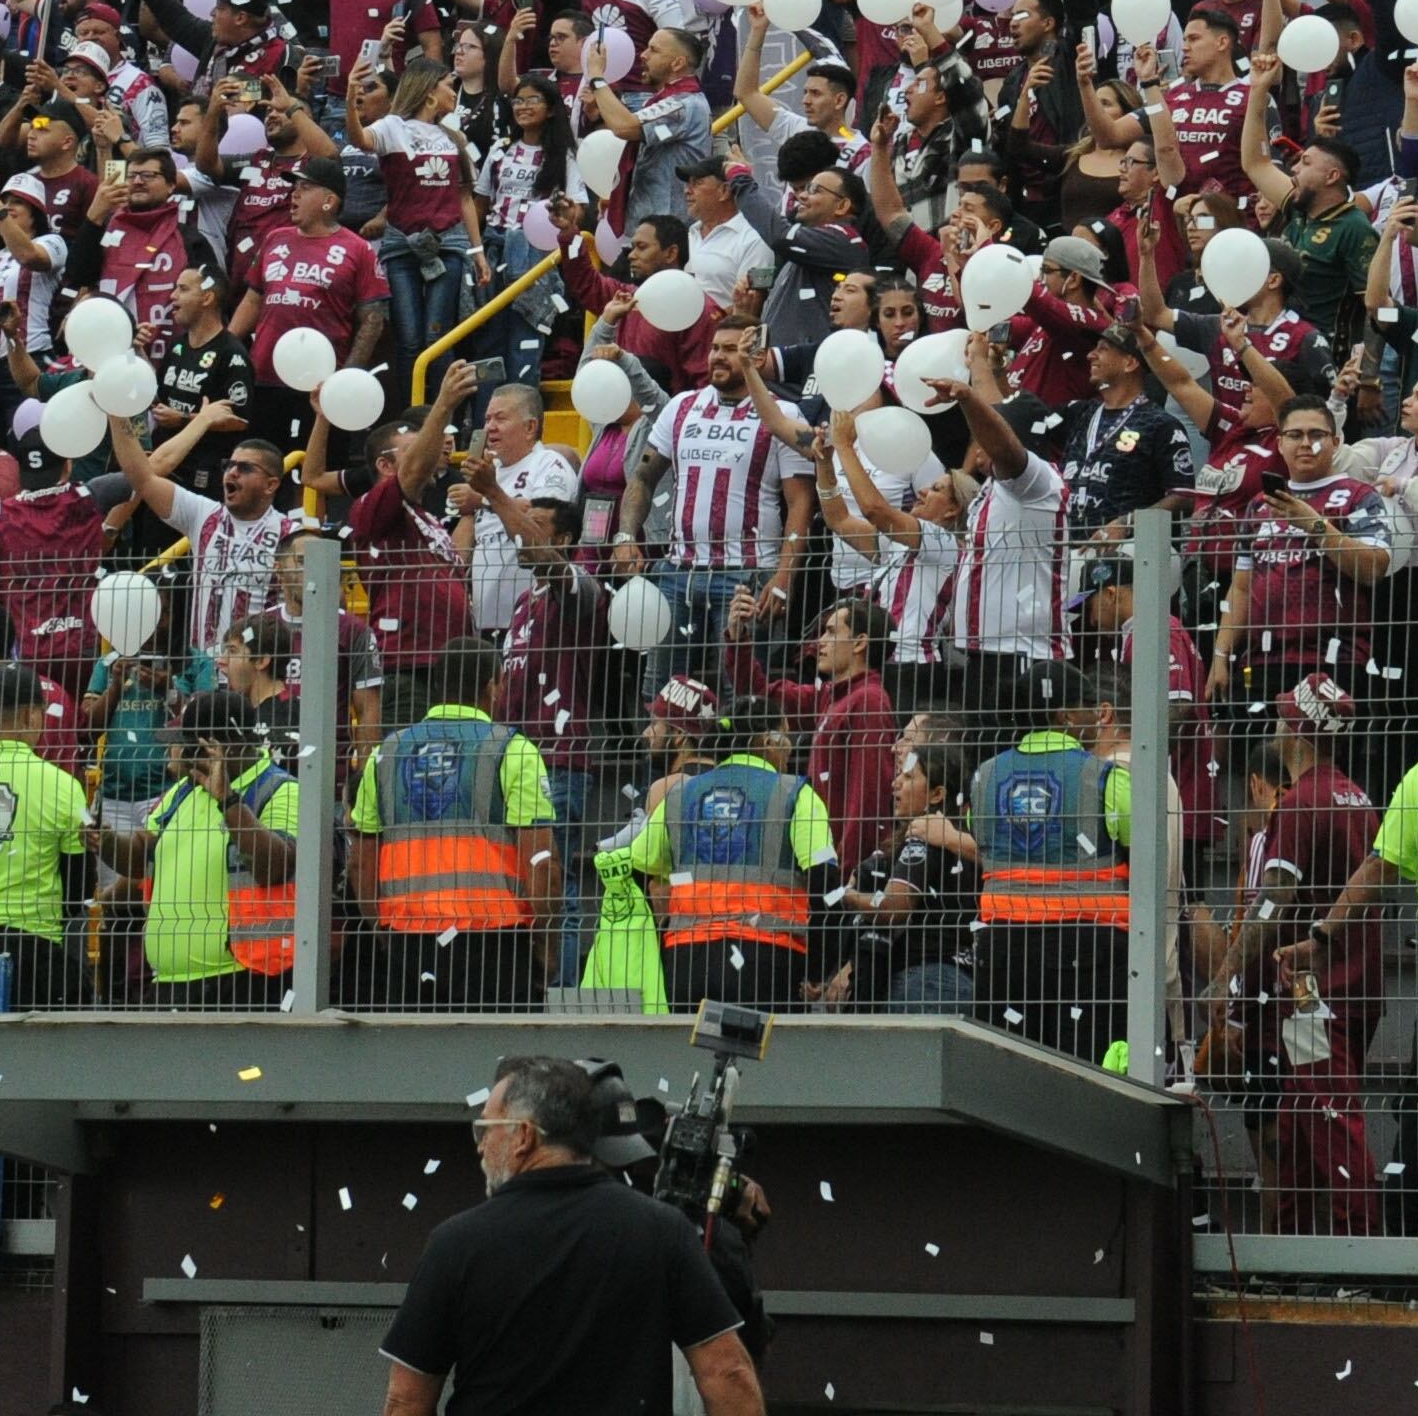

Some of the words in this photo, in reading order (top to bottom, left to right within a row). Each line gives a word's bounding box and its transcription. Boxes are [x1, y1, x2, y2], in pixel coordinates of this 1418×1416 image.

[1241, 14, 1253, 26] S
[977, 56, 1027, 69] LIBERTY
[109, 86, 124, 102] S
[1226, 90, 1244, 106] S
[1191, 108, 1231, 125] BAC
[516, 169, 535, 180] BA
[53, 190, 71, 205] S
[244, 194, 287, 206] LIBERTY
[1312, 227, 1331, 244] S
[327, 245, 346, 264] S
[292, 263, 334, 283] BAC
[267, 293, 321, 308] LIBERTY
[1270, 334, 1289, 351] S
[200, 351, 217, 368] S
[707, 424, 751, 442] BAC
[1116, 430, 1140, 452] S
[29, 452, 43, 468] S
[681, 449, 745, 463] LIBERY
[516, 472, 529, 490] S
[1325, 489, 1351, 508] S
[263, 532, 279, 548] S
